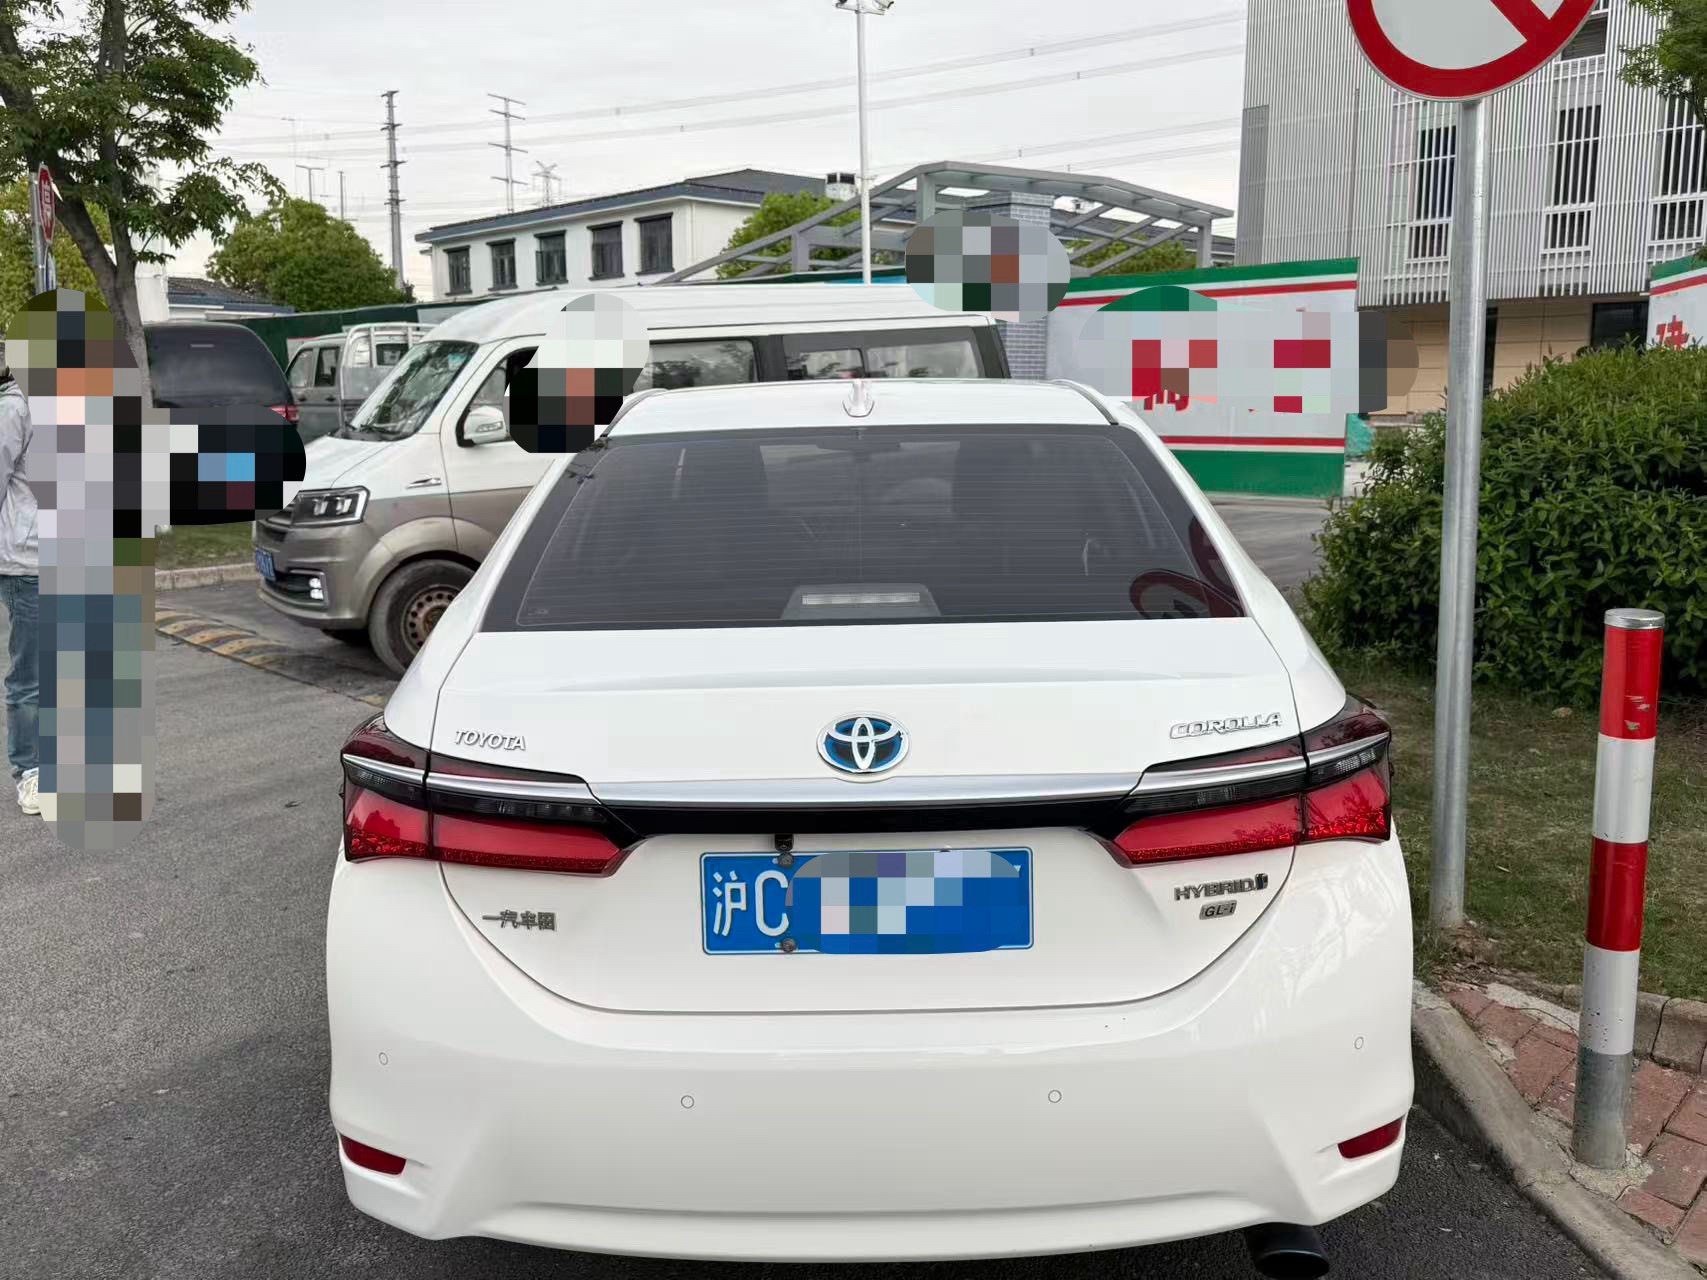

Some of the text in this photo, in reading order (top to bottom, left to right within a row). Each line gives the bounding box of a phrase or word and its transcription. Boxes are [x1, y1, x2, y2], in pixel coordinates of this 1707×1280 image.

[1169, 711, 1283, 740] COROLLA
[455, 729, 527, 752] TOYOTA
[1173, 877, 1256, 902] HYBRID
